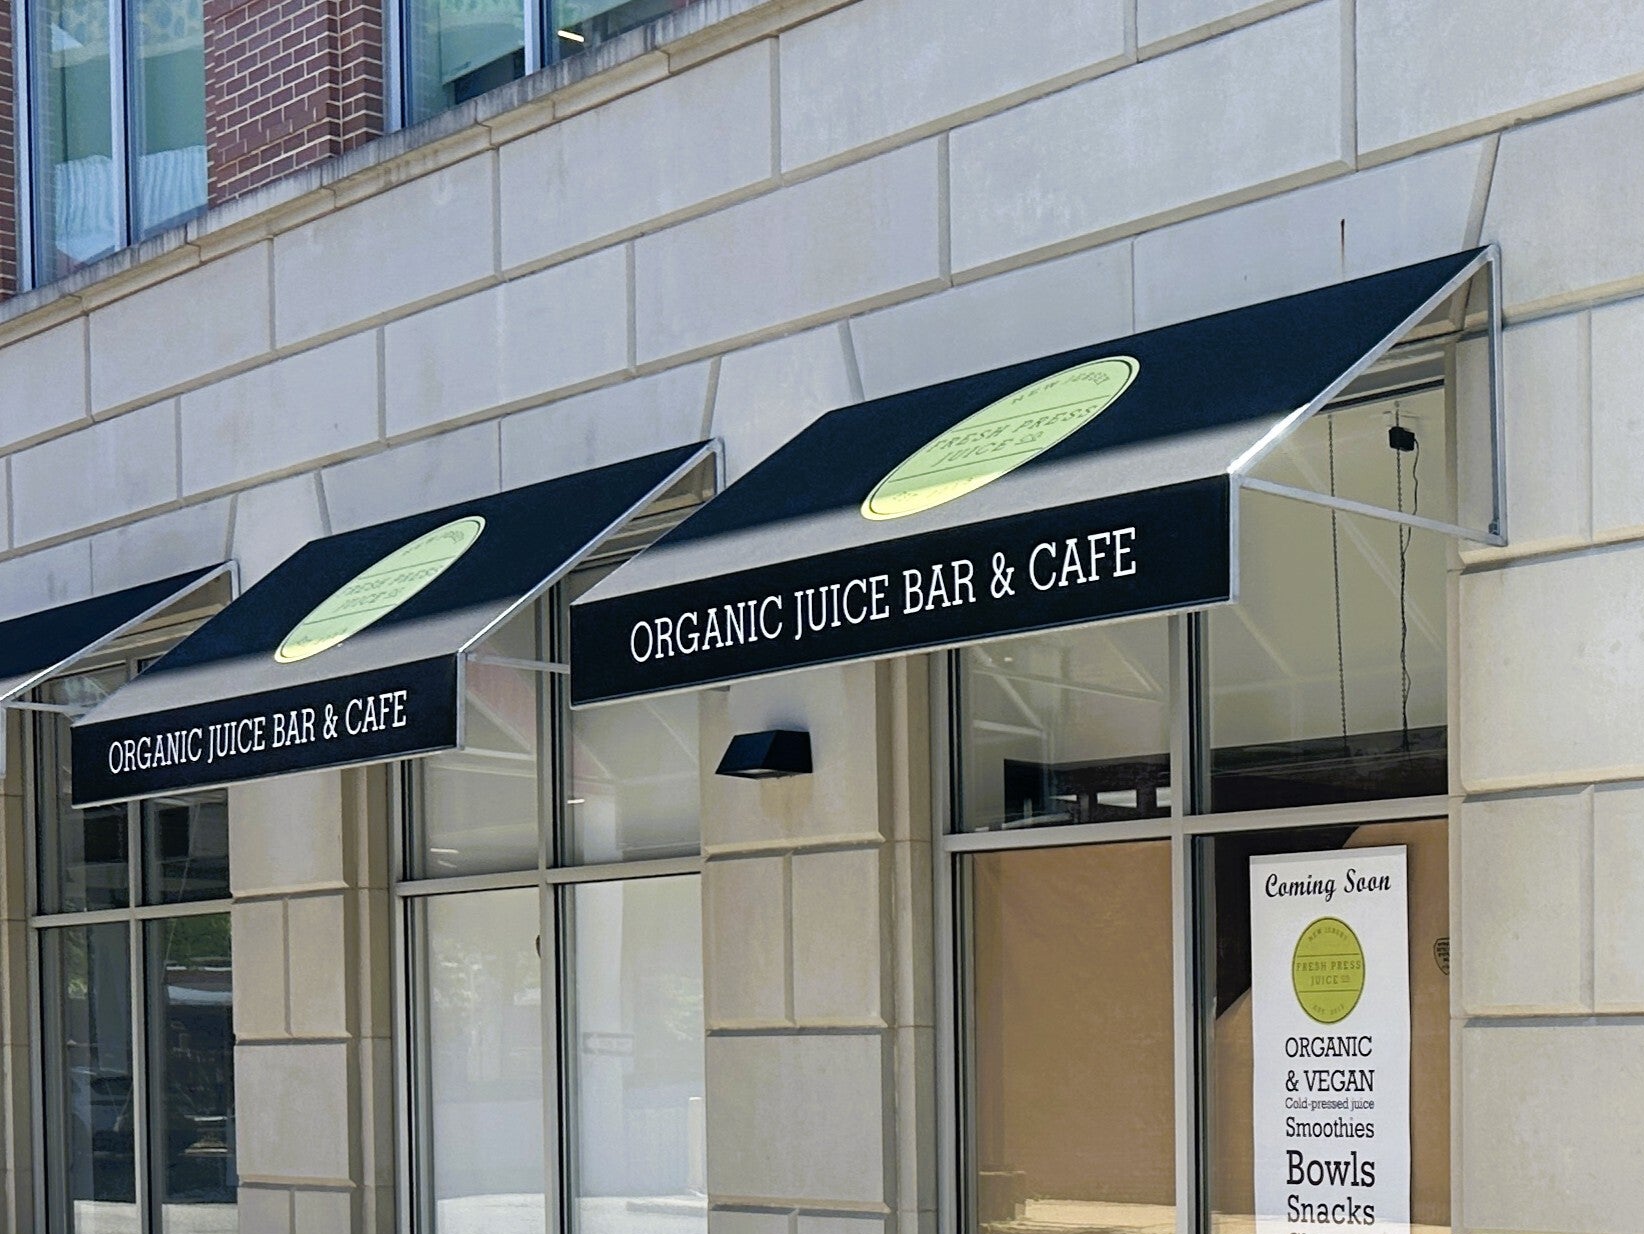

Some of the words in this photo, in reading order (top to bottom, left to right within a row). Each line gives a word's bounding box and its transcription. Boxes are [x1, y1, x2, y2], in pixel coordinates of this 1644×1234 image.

[927, 424, 1011, 453] FRESH
[1014, 404, 1099, 433] PRESS
[930, 438, 1013, 468] JUICE
[630, 594, 783, 664] ORGANIC
[794, 574, 890, 641] JUICE
[902, 558, 977, 616] BAR
[989, 551, 1016, 599] &
[1028, 526, 1137, 592] CAFE
[108, 727, 202, 774] ORGANIC
[207, 716, 266, 764] JUICE
[272, 707, 316, 749] BAR
[322, 703, 339, 740] &
[345, 689, 408, 736] CAFE
[1264, 872, 1338, 903] Coming
[1343, 868, 1392, 894] Soon
[1295, 961, 1327, 972] FRESH
[1330, 959, 1361, 971] PRESS
[1310, 974, 1338, 987] JUICE
[1284, 1035, 1374, 1059] ORGANIC
[1285, 1069, 1299, 1093] &
[1303, 1069, 1376, 1093] VEGAN
[1284, 1097, 1350, 1111] Cold-pressed
[1350, 1098, 1375, 1111] juice
[1285, 1116, 1375, 1139] Smoothies
[1286, 1149, 1376, 1188] Bowls
[1287, 1193, 1375, 1226] Snacks
